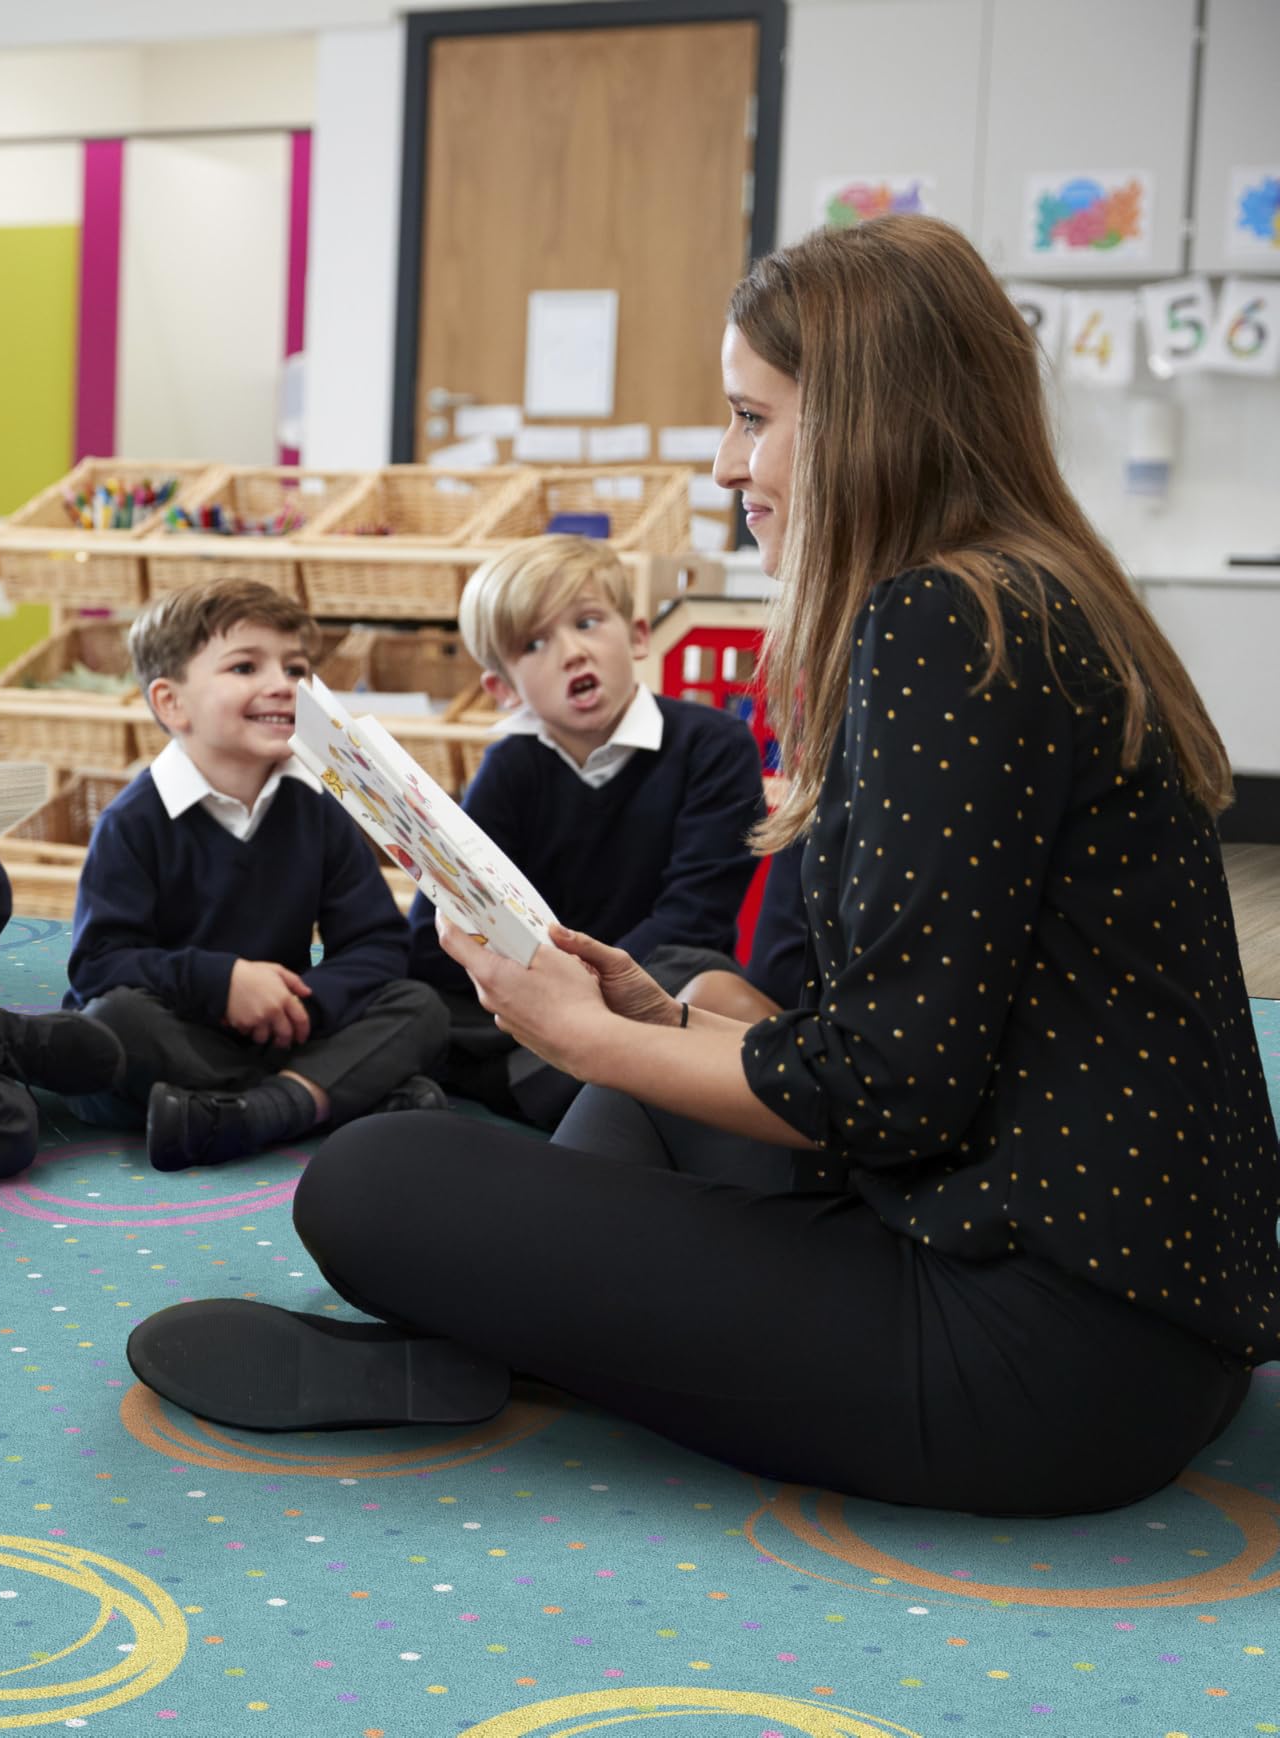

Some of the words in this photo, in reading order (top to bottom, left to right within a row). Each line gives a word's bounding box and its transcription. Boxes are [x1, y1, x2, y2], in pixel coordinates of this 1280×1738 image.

[1074, 309, 1112, 367] 4
[1168, 295, 1203, 358] 5
[1227, 298, 1266, 358] 6
